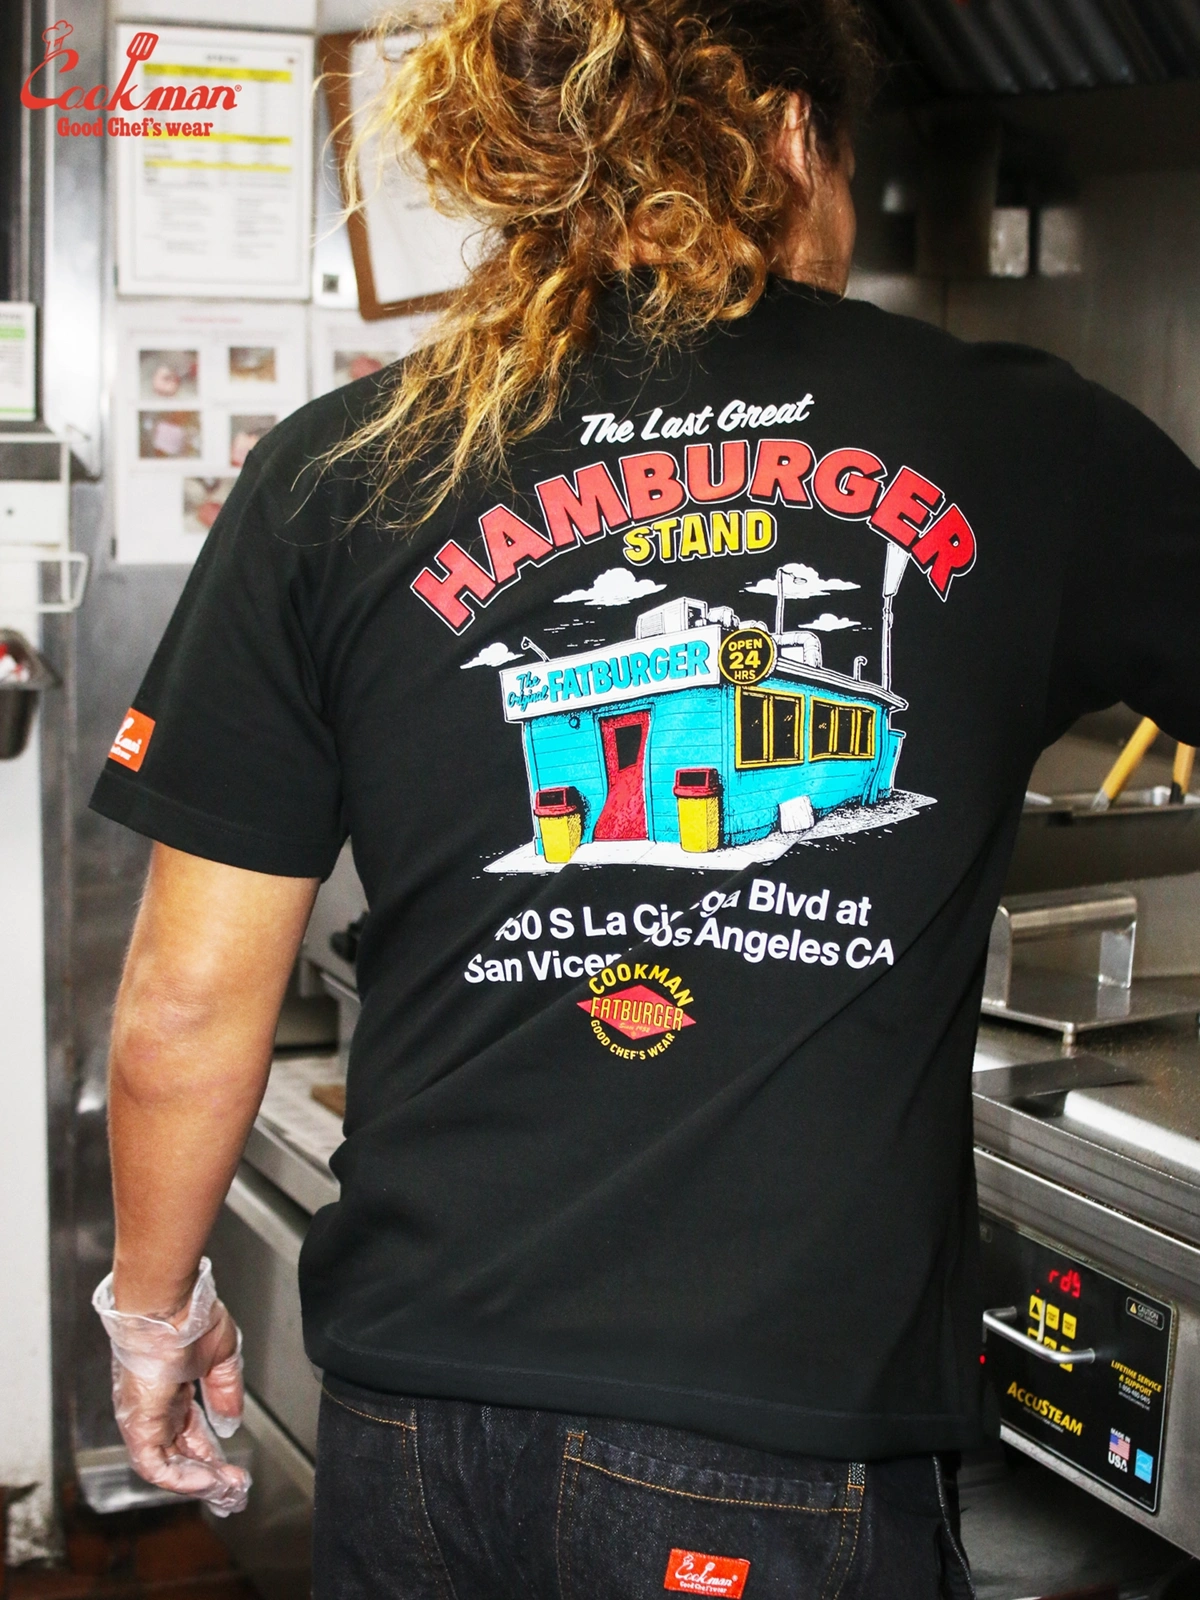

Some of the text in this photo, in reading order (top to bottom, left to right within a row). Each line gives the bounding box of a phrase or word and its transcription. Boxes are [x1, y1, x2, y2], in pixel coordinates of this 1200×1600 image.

[580, 393, 814, 446] The Last Great
[410, 438, 978, 636] HAMBURGER
[623, 509, 777, 566] STAND
[728, 638, 763, 651] OPEN
[729, 650, 761, 669] 24
[516, 671, 541, 690] The
[547, 640, 711, 703] FATBURGER
[734, 670, 756, 681] HRS
[507, 685, 549, 712] Original
[550, 908, 575, 939] S
[583, 906, 627, 937] La
[748, 878, 830, 921] Blvd
[835, 896, 872, 927] at
[464, 953, 523, 984] San
[693, 917, 841, 966] Angeles
[845, 937, 895, 969] CA
[589, 963, 694, 1007] COOKMAN
[590, 996, 684, 1031] FATBURGER
[591, 1019, 676, 1060] GOOD CHEF'S WEAR
[1125, 1377, 1152, 1397] SUPPORT
[1137, 1374, 1162, 1392] SERVICE
[1108, 1451, 1128, 1473] USA
